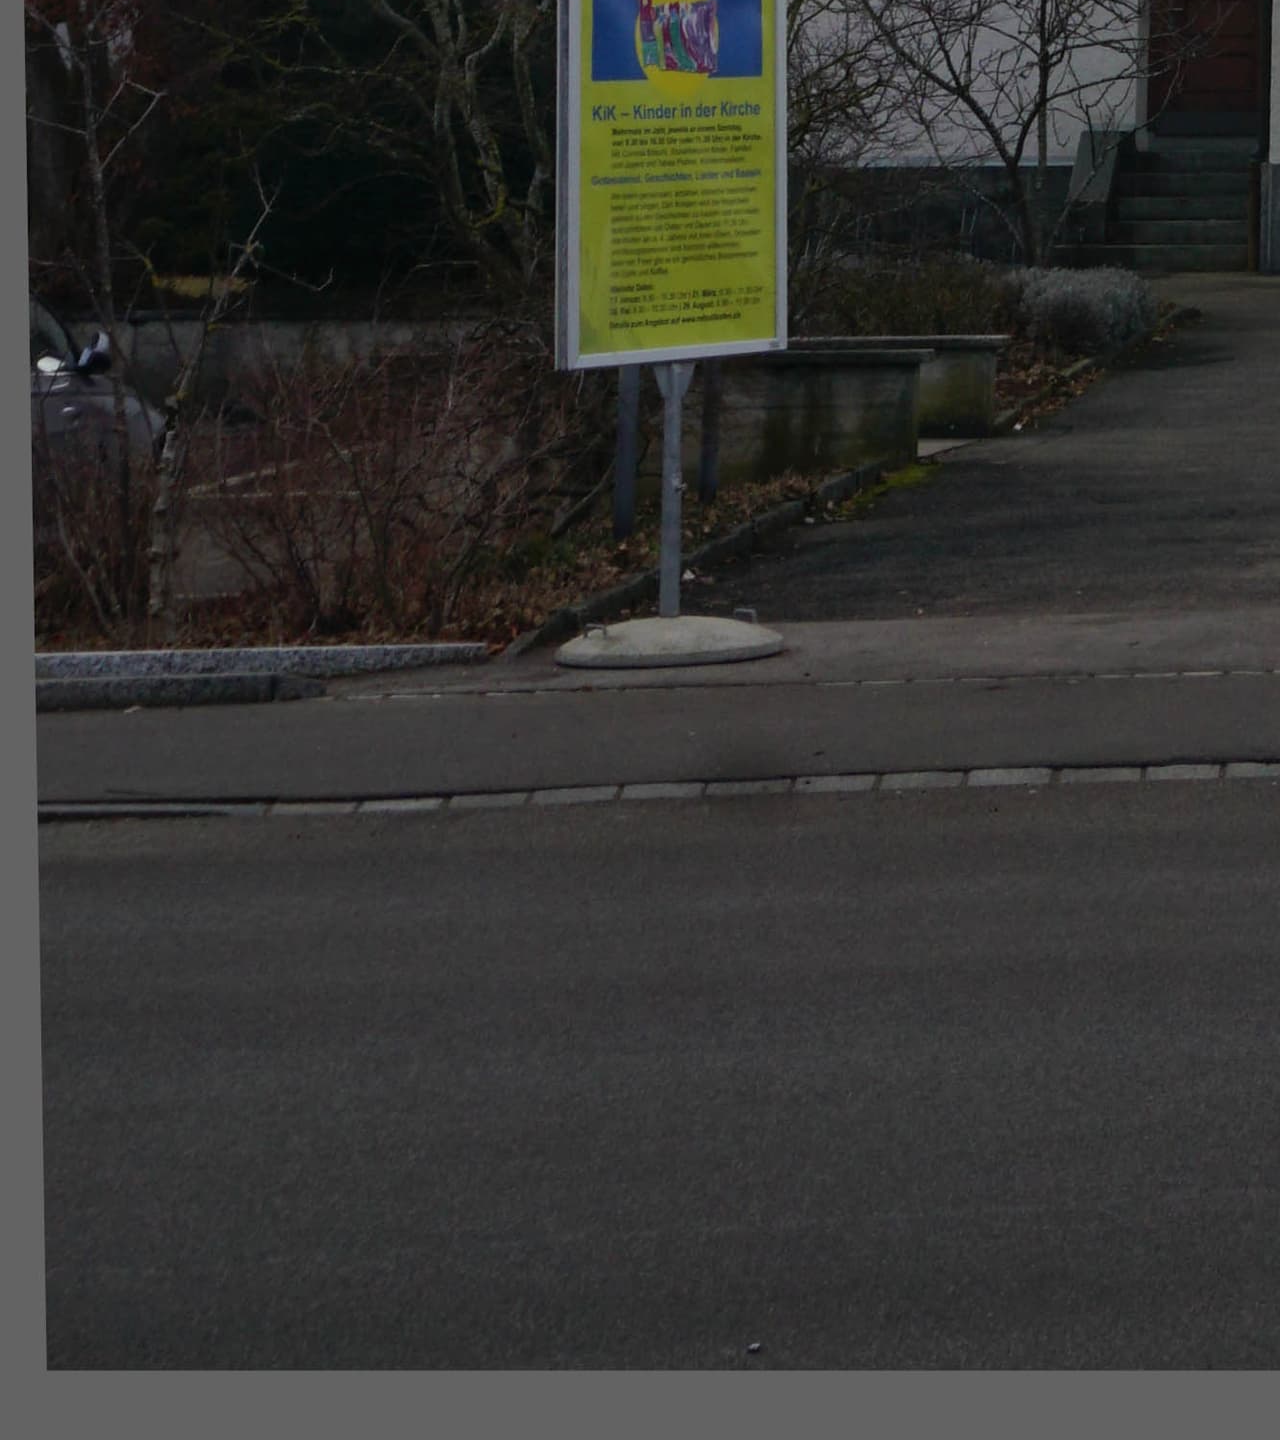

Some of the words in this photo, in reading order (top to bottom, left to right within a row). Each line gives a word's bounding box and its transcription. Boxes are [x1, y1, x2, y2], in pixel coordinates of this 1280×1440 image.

[592, 104, 617, 121] KiK
[633, 104, 678, 120] Kinder
[680, 103, 692, 118] in
[695, 103, 717, 118] der
[721, 101, 761, 117] Kirche
